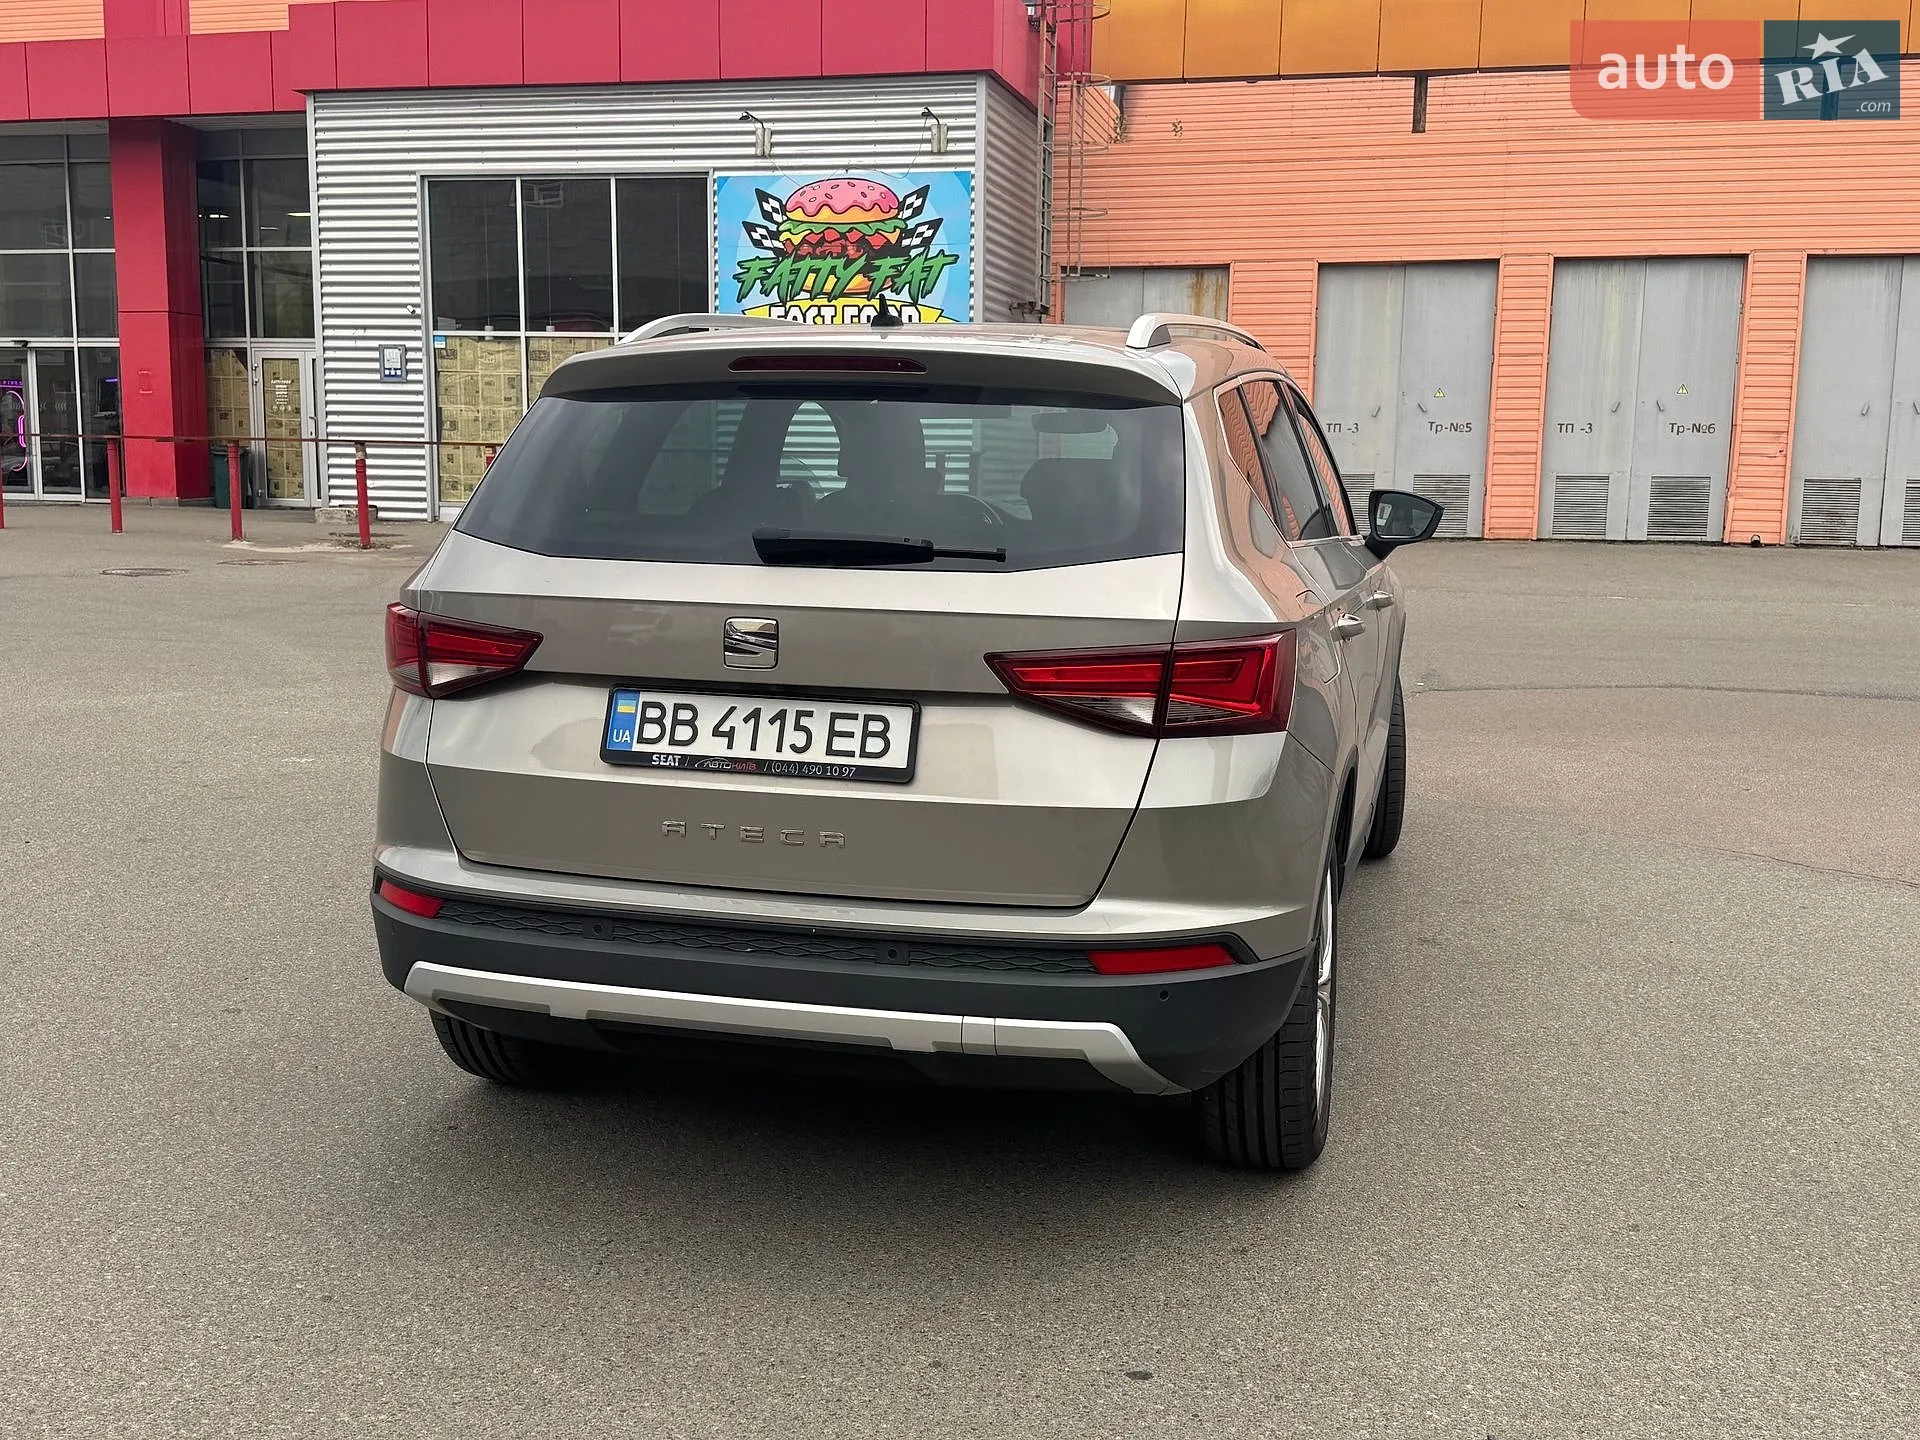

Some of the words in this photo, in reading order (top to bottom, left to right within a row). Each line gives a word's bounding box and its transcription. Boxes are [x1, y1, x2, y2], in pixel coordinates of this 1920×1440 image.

[732, 251, 868, 303] FATTY
[863, 245, 960, 304] FAT
[842, 304, 922, 325] FOD
[612, 729, 631, 743] UA
[636, 701, 699, 747] BB
[711, 705, 815, 754] 4115
[825, 711, 892, 760] EB
[651, 754, 681, 767] SEAT
[771, 761, 799, 774] (044)
[801, 764, 823, 775] 490
[826, 765, 840, 776] 10
[841, 766, 856, 777] 97
[661, 819, 846, 849] ATECA
